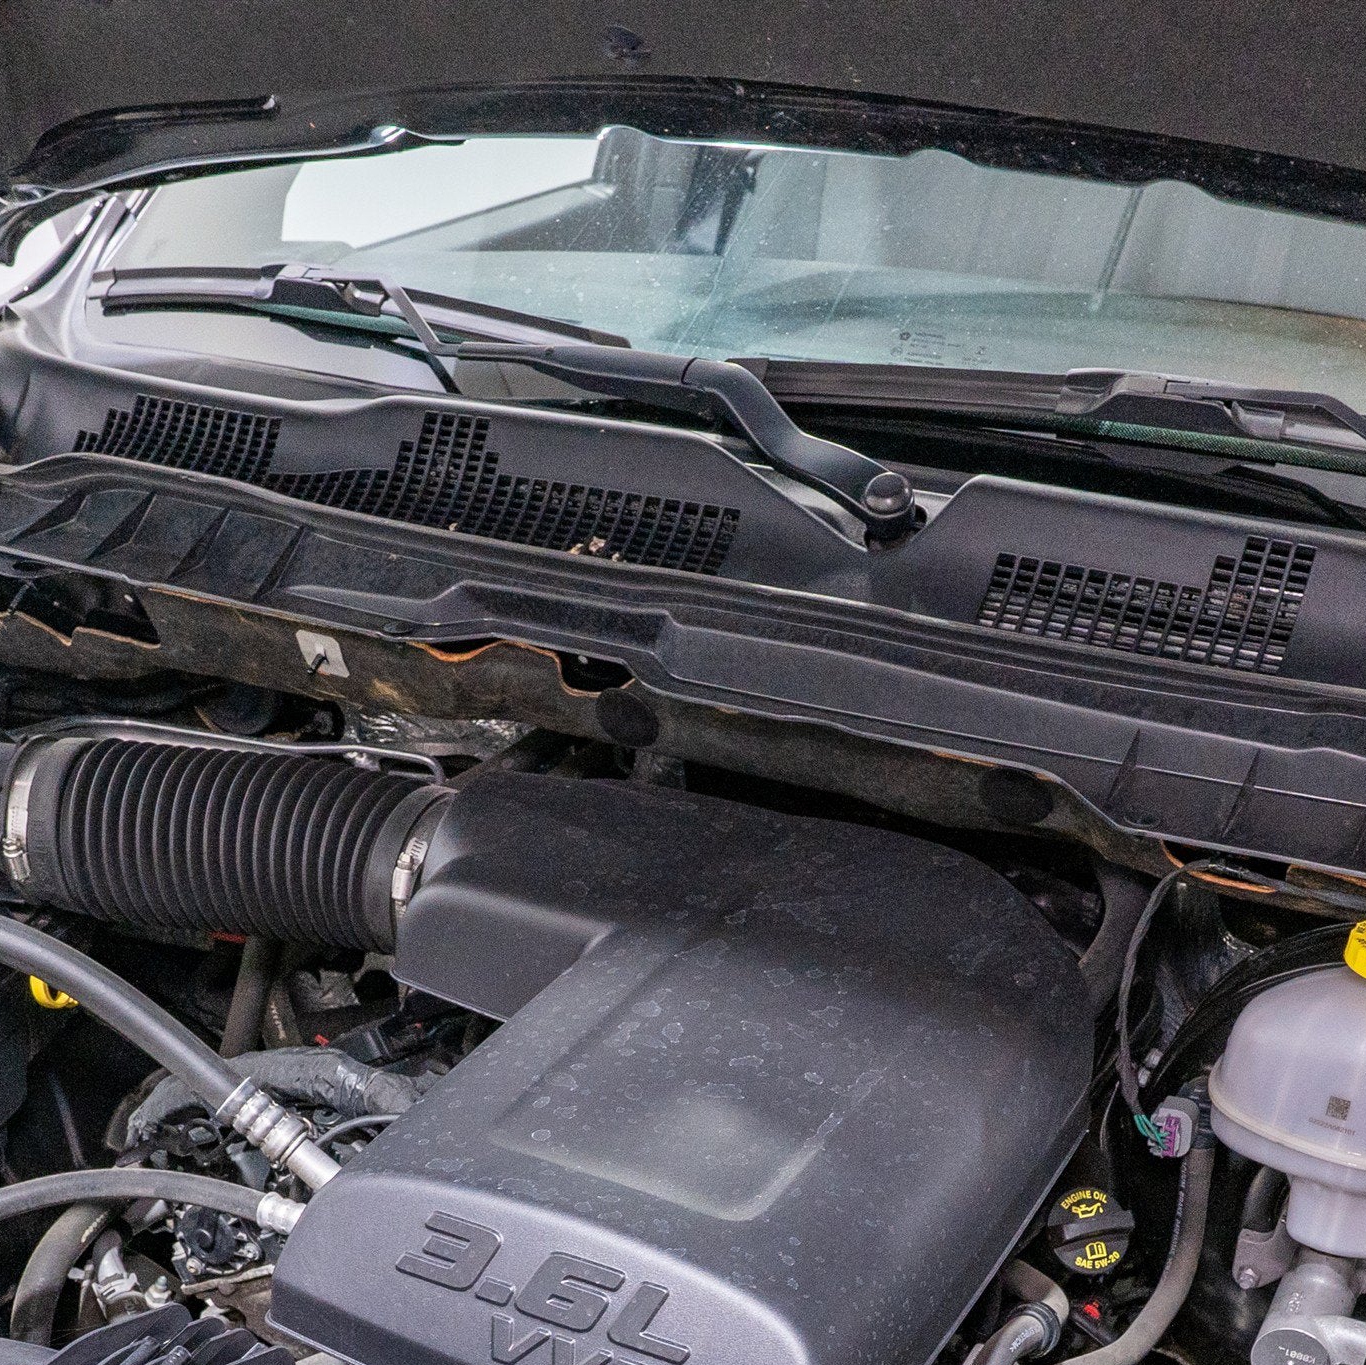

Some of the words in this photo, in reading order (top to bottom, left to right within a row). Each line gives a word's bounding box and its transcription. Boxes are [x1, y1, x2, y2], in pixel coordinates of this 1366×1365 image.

[1061, 1190, 1092, 1209] ENGINE
[1093, 1191, 1107, 1203] OIL
[1075, 1257, 1093, 1269] SAE
[1094, 1251, 1120, 1269] 5W-20
[395, 1210, 691, 1365] 3.6L
